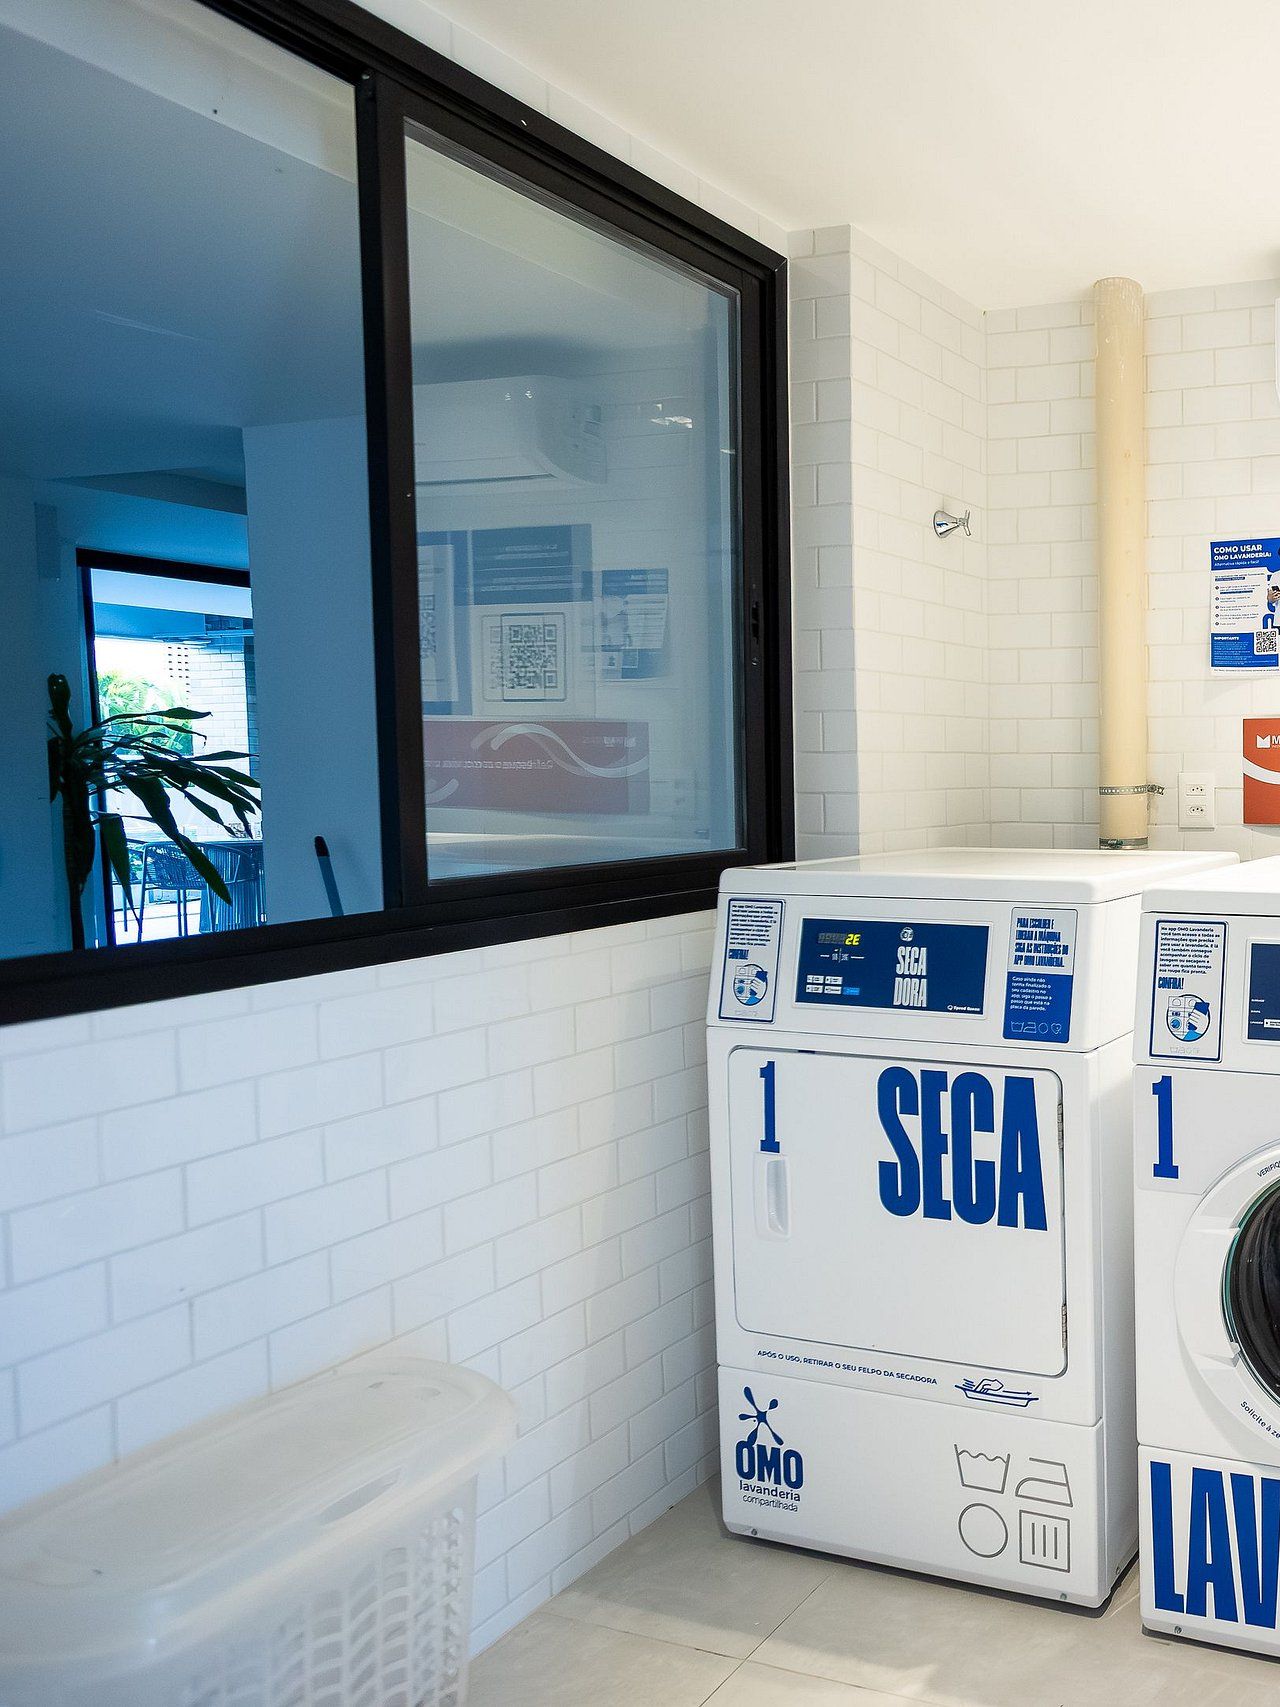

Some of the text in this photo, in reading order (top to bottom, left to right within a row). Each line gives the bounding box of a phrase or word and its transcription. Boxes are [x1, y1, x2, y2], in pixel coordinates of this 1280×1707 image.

[1213, 544, 1262, 554] COMO USAR
[895, 946, 927, 976] SECA
[893, 977, 927, 1007] DORA
[759, 1060, 780, 1154] 1
[1152, 1074, 1179, 1180] 1
[876, 1065, 1048, 1232] SECA
[757, 1350, 777, 1359] APÓS
[785, 1354, 802, 1363] USO,
[803, 1357, 834, 1367] RETIRAR
[842, 1364, 857, 1372] SEU
[858, 1366, 882, 1376] FELPO
[883, 1370, 895, 1378] DA
[896, 1372, 938, 1385] SECADORA
[1240, 1401, 1266, 1428] Solicite
[1266, 1424, 1272, 1432] à
[736, 1439, 804, 1490] OMO
[739, 1480, 801, 1502] lavanderia
[742, 1493, 799, 1512] compartilhada
